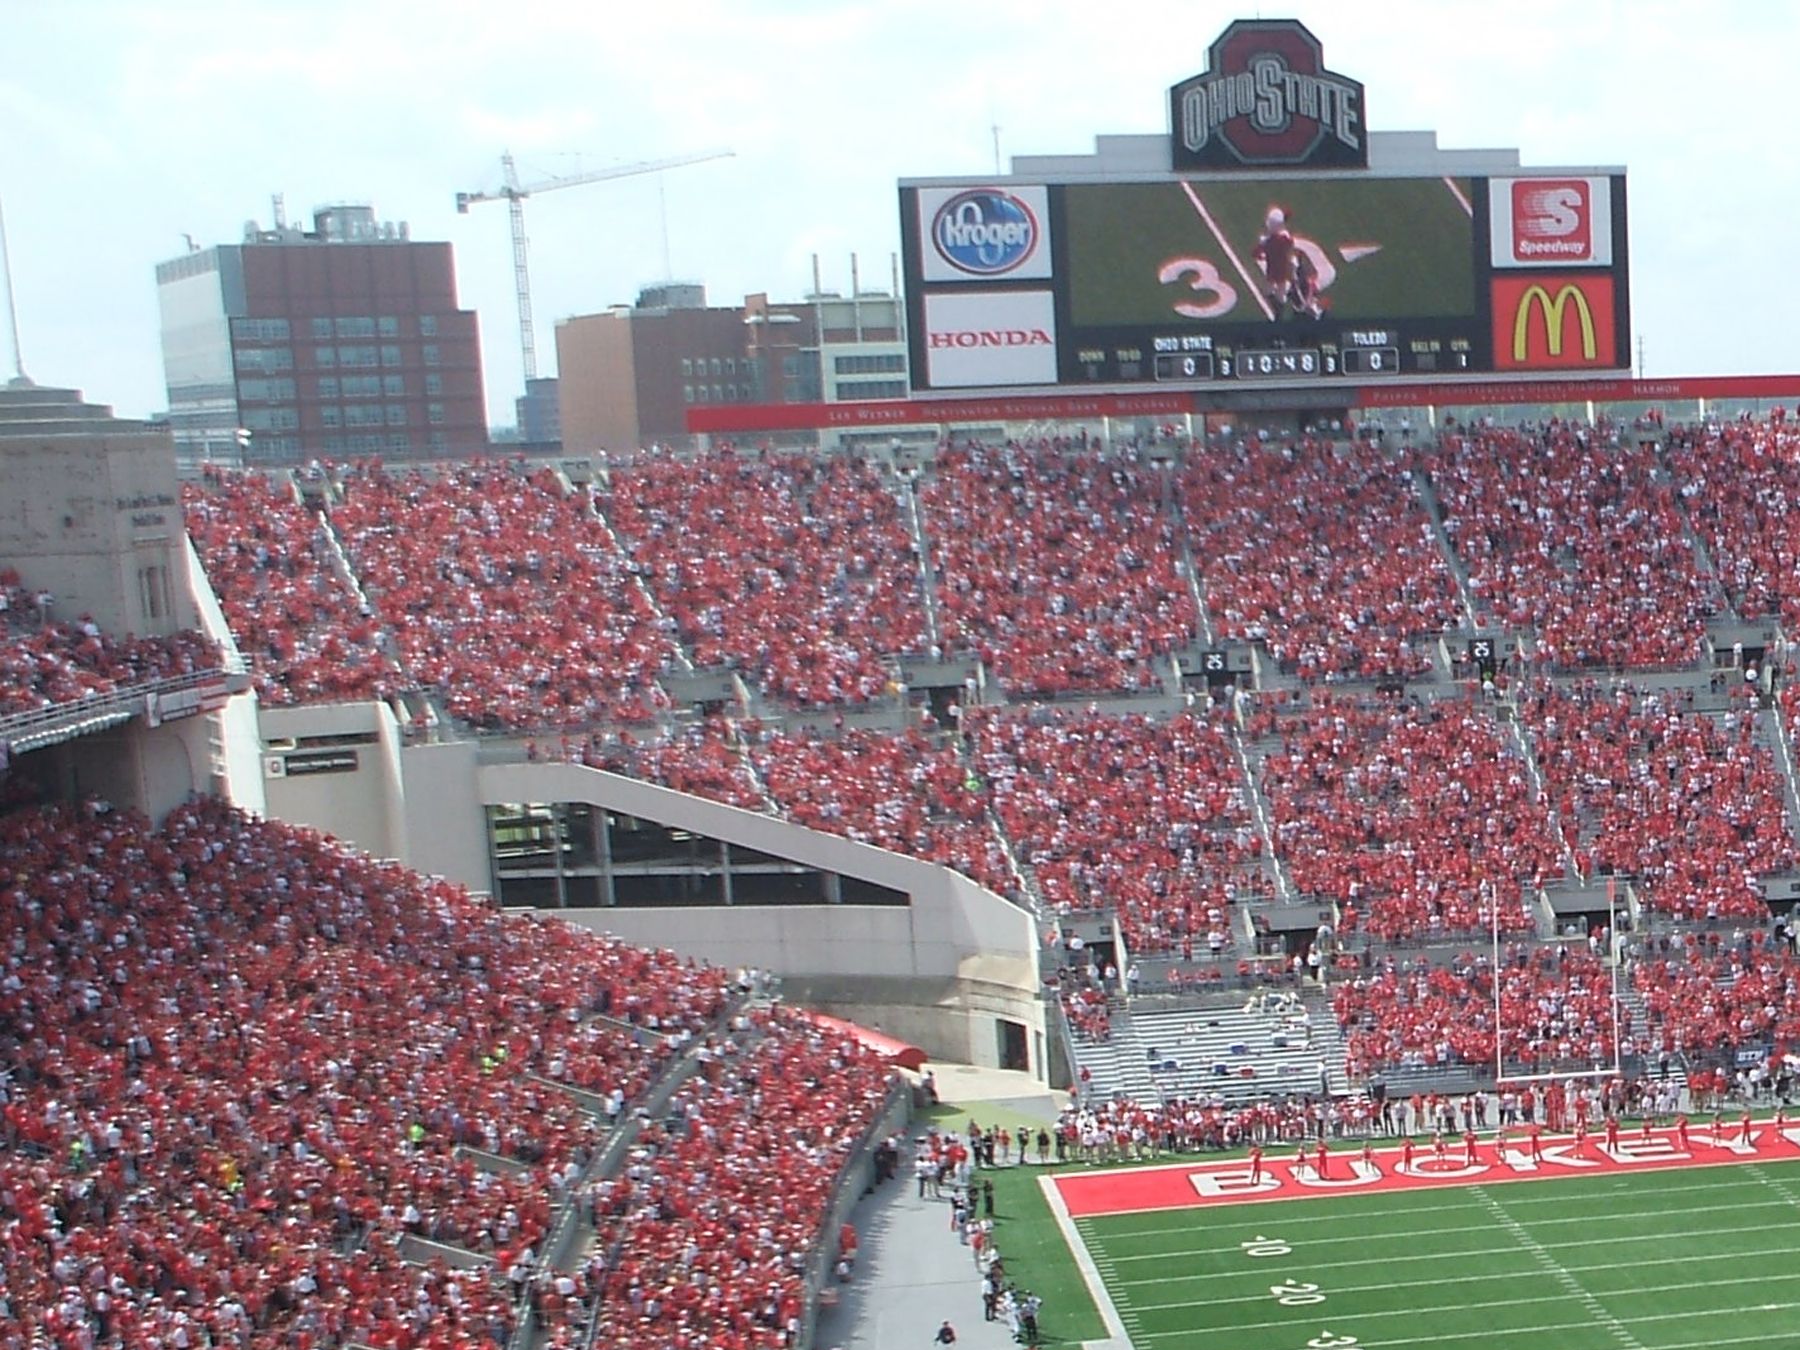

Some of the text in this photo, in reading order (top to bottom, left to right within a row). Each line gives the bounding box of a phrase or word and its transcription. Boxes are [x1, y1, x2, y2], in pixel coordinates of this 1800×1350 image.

[1182, 57, 1361, 153] OHIO STATE
[944, 201, 1030, 266] Kroger
[1518, 239, 1586, 256] Speedway
[929, 329, 1054, 350] HONDA
[1154, 336, 1212, 351] OHIO STATE
[1353, 332, 1388, 346] TOLEDO
[1241, 1238, 1293, 1256] 10
[1269, 1283, 1326, 1305] 20
